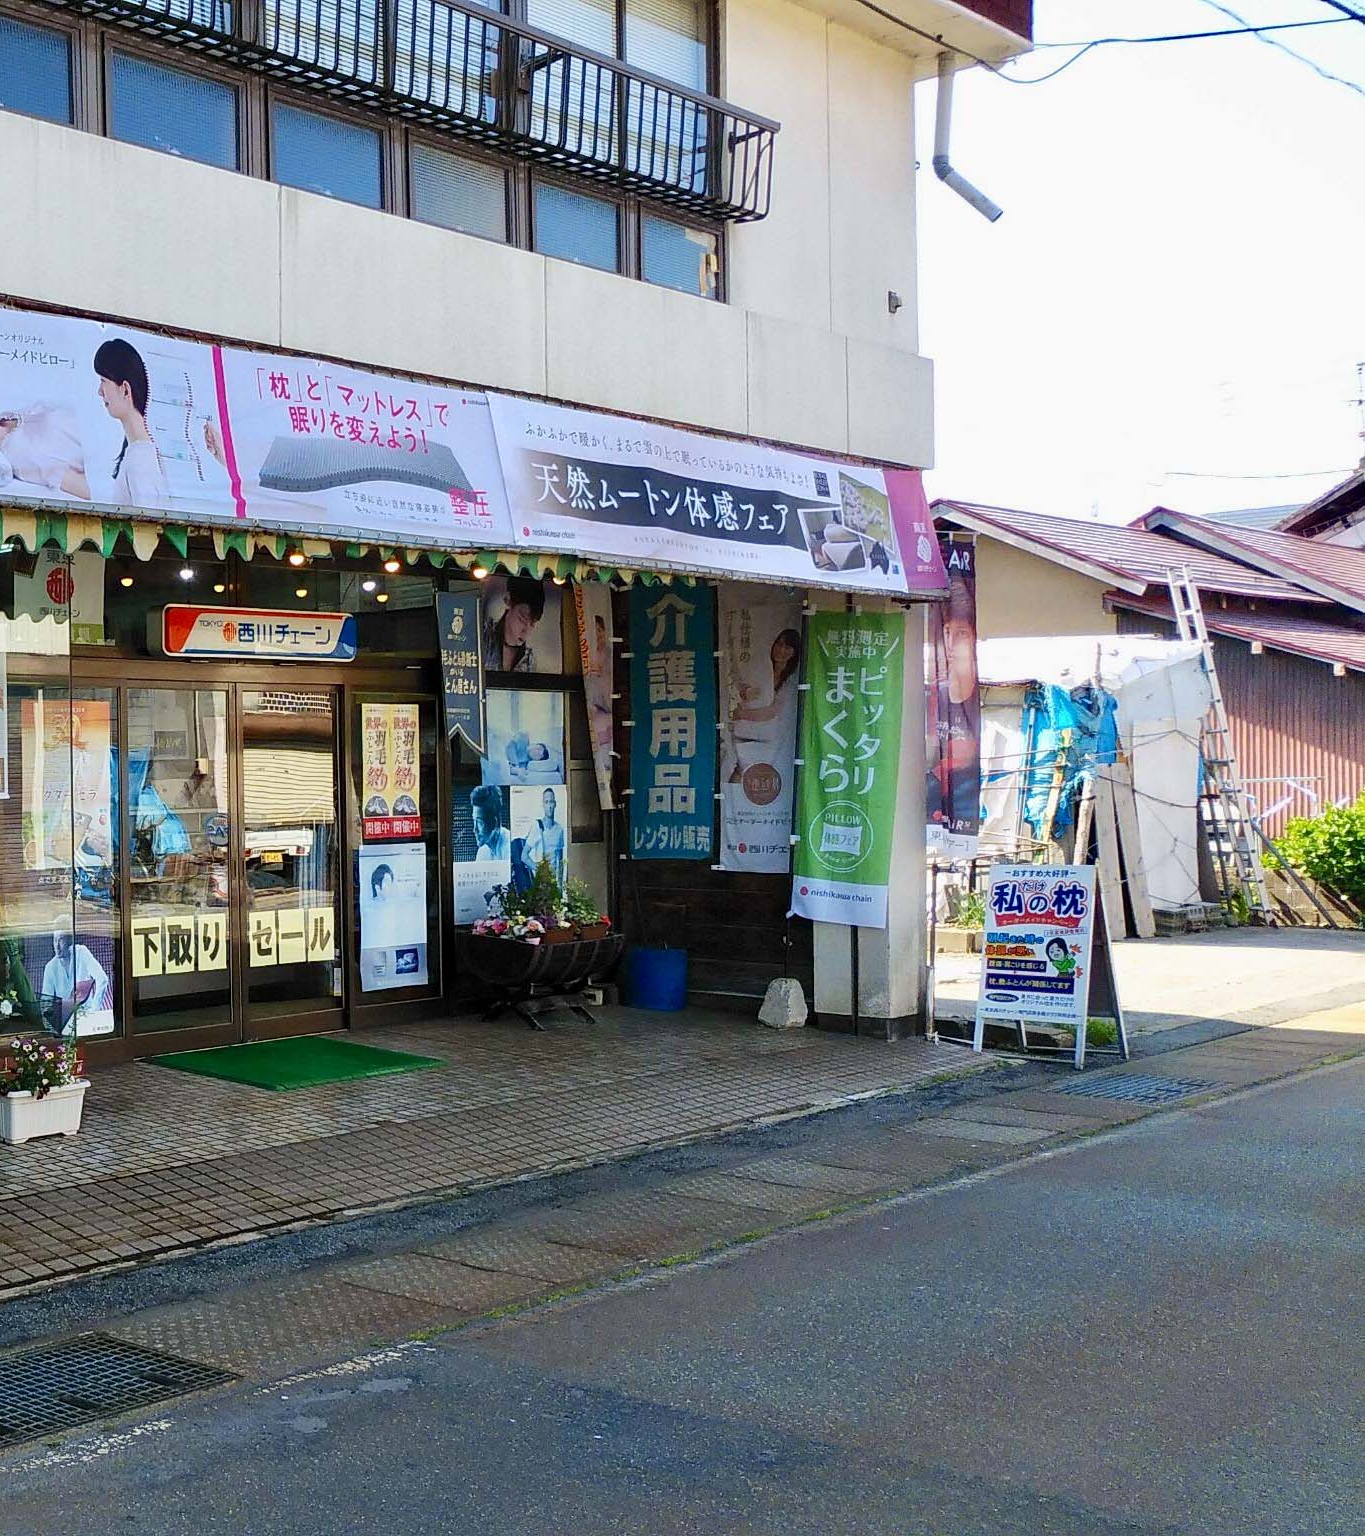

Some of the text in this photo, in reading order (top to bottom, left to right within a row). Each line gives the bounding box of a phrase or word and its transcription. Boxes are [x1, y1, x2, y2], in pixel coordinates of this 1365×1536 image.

[256, 367, 449, 428] 「枕」と「マットレス」で
[530, 461, 789, 537] 天然ムートン体感フェア
[198, 619, 224, 629] TOKYO
[237, 621, 332, 646] 西川チェーン
[645, 593, 698, 815] 介護用品
[818, 665, 856, 794] まくら
[852, 666, 888, 796] ピッタリ
[634, 823, 711, 854] レンタル販売
[824, 812, 862, 826] PILLOW
[810, 887, 873, 905] nishikawa chain
[992, 883, 1086, 917] 私の枕
[134, 920, 221, 970] 下取り
[251, 915, 332, 958] セール
